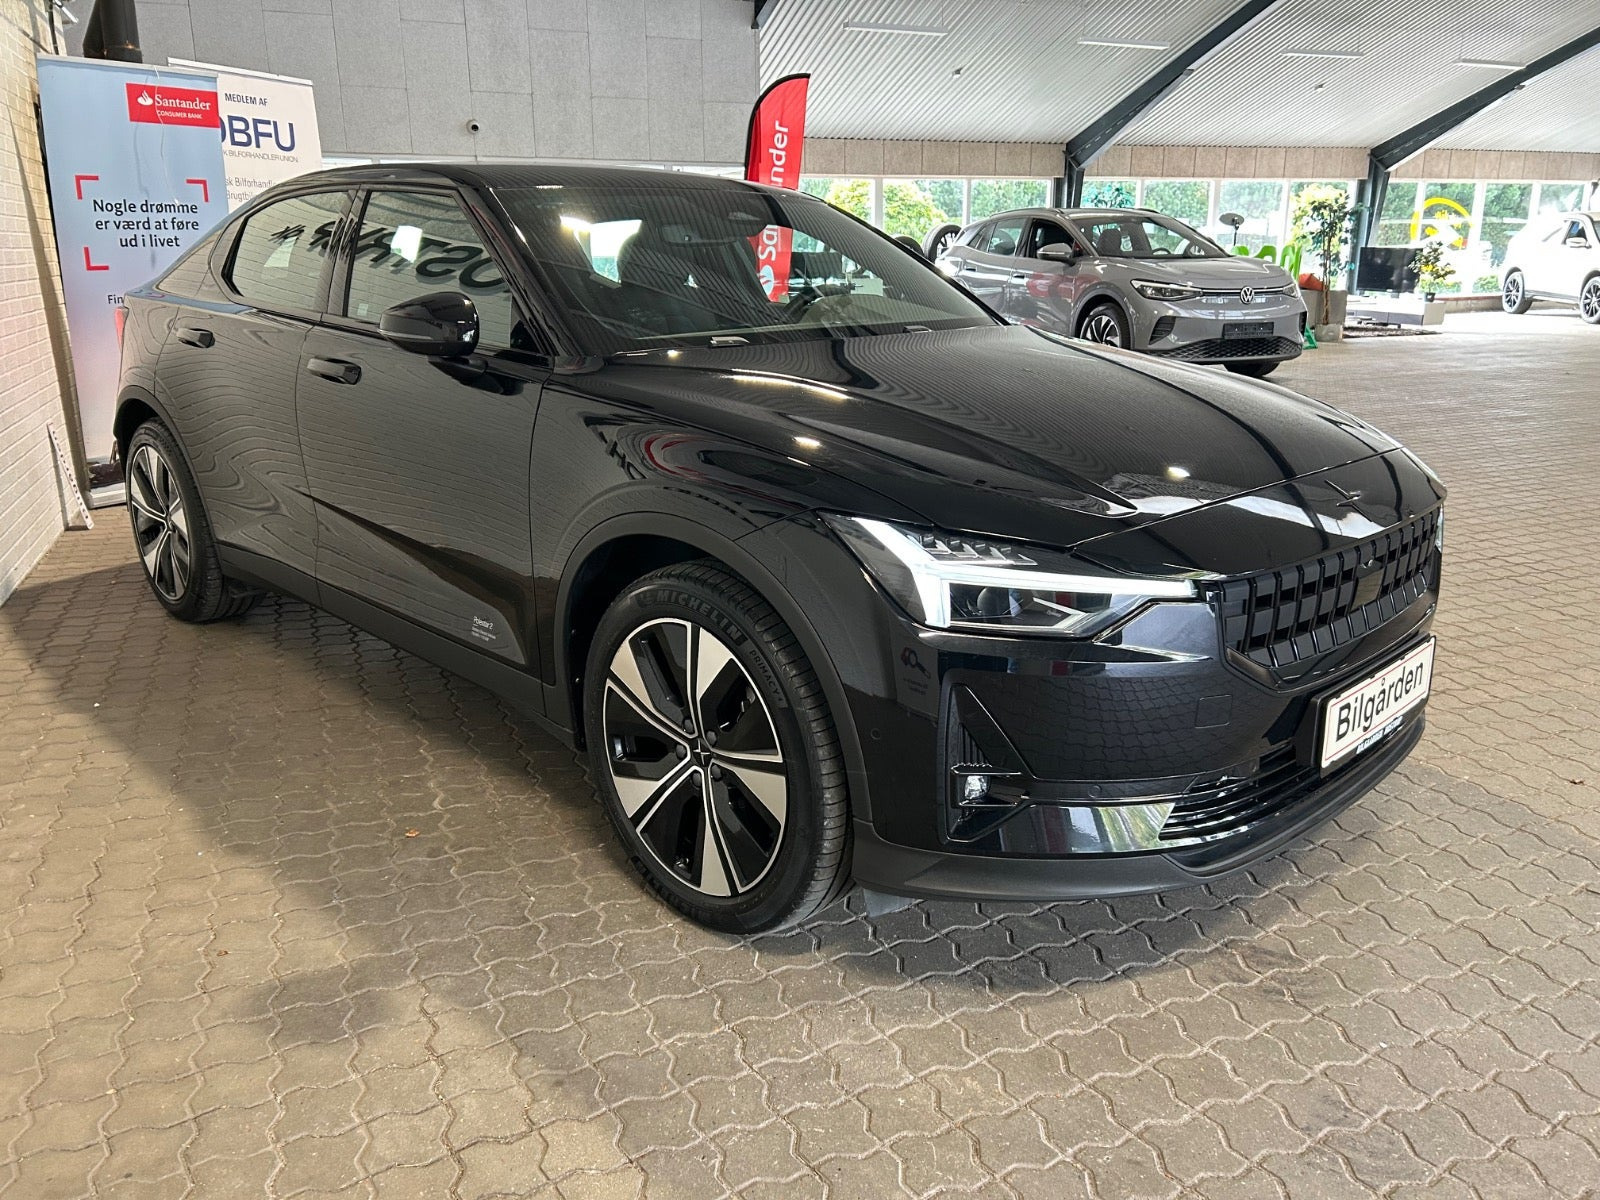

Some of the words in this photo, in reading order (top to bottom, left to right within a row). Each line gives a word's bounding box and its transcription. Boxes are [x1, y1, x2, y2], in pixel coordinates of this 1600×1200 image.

[155, 94, 211, 110] Santander
[224, 92, 257, 106] MEDLEM
[258, 97, 268, 106] AF
[157, 110, 187, 119] CONSUMER
[769, 120, 789, 187] nder
[235, 177, 276, 188] Bilforhandl
[93, 199, 137, 216] Nogle
[140, 199, 198, 214] drømme
[95, 220, 110, 230] er
[113, 217, 151, 230] værd
[154, 218, 169, 230] at
[171, 217, 199, 230] føre
[119, 234, 138, 247] ud
[141, 234, 146, 247] i
[149, 234, 180, 247] livet
[107, 294, 124, 304] Fin
[656, 589, 743, 643] MICHELIN
[749, 650, 780, 695] PRIMACY
[1335, 661, 1424, 743] Bilgården
